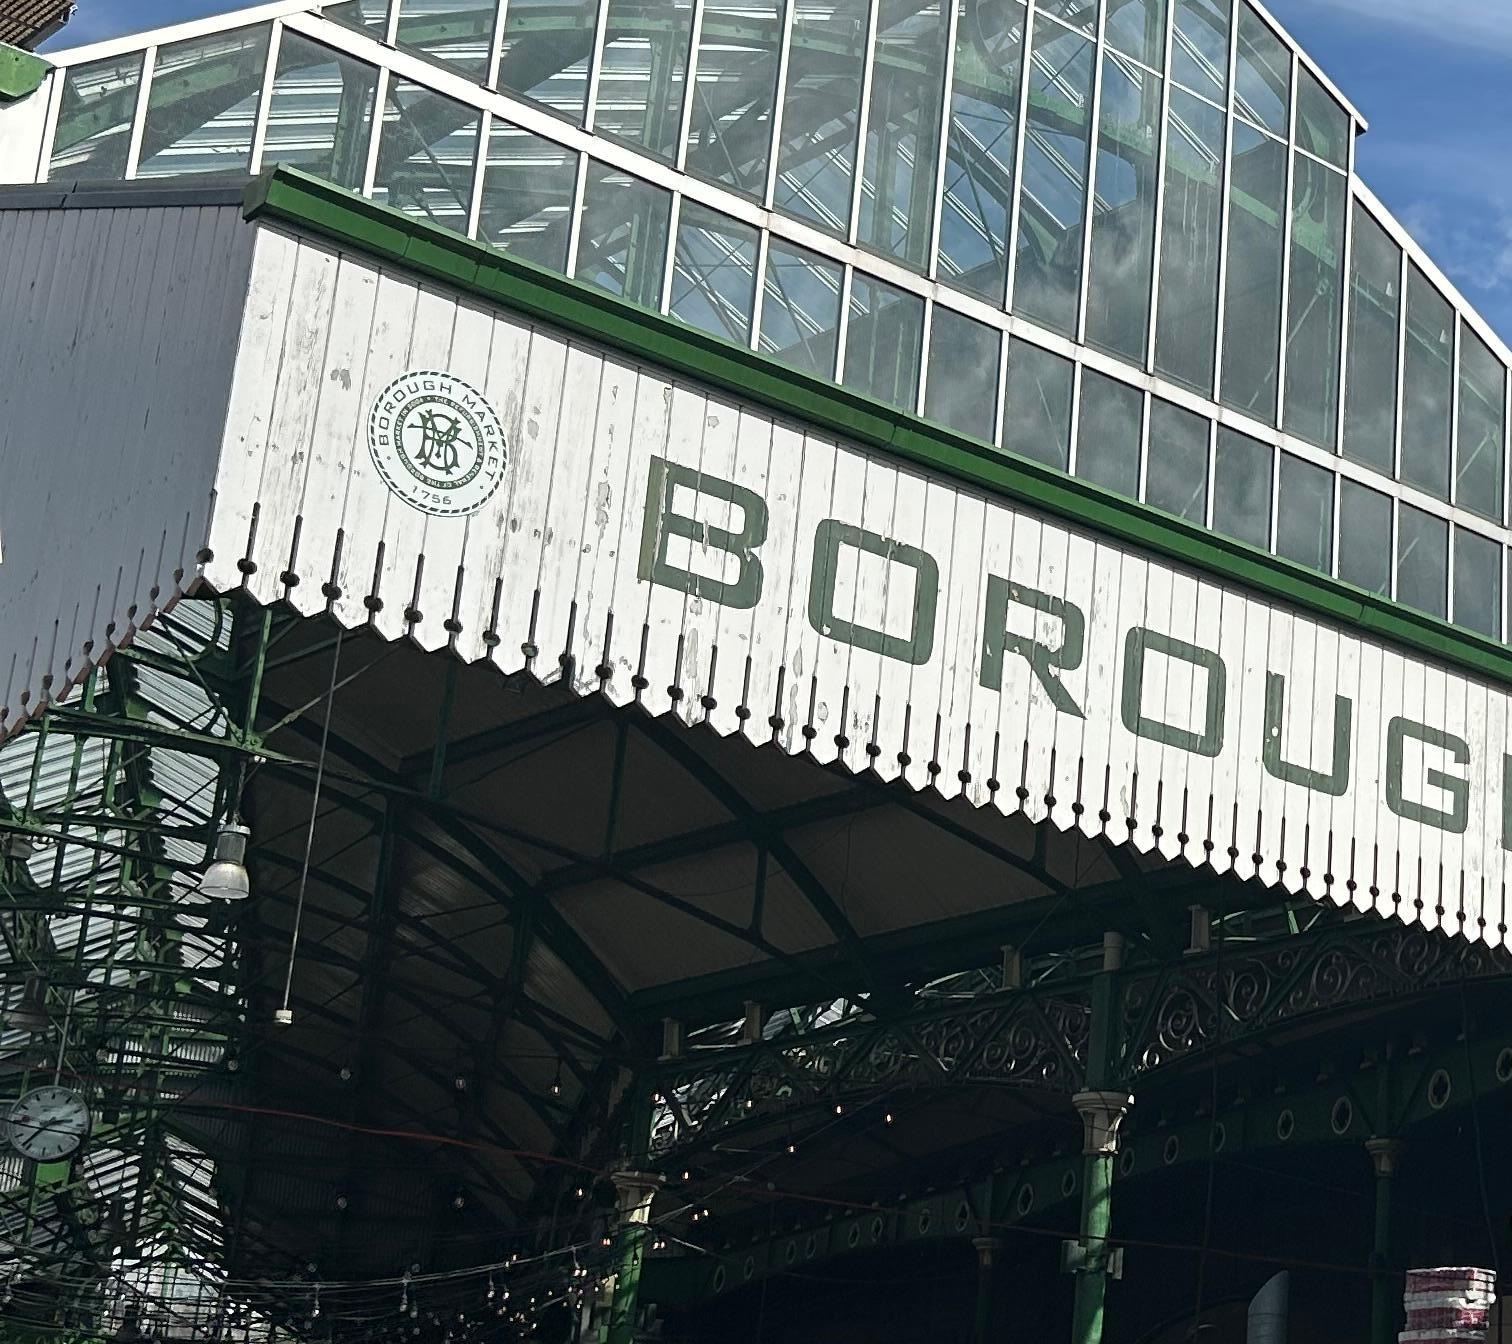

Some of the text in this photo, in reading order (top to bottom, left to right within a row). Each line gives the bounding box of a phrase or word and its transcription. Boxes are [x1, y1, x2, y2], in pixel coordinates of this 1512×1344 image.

[379, 380, 499, 482] BOROUGH MARKET
[411, 485, 453, 505] 1756
